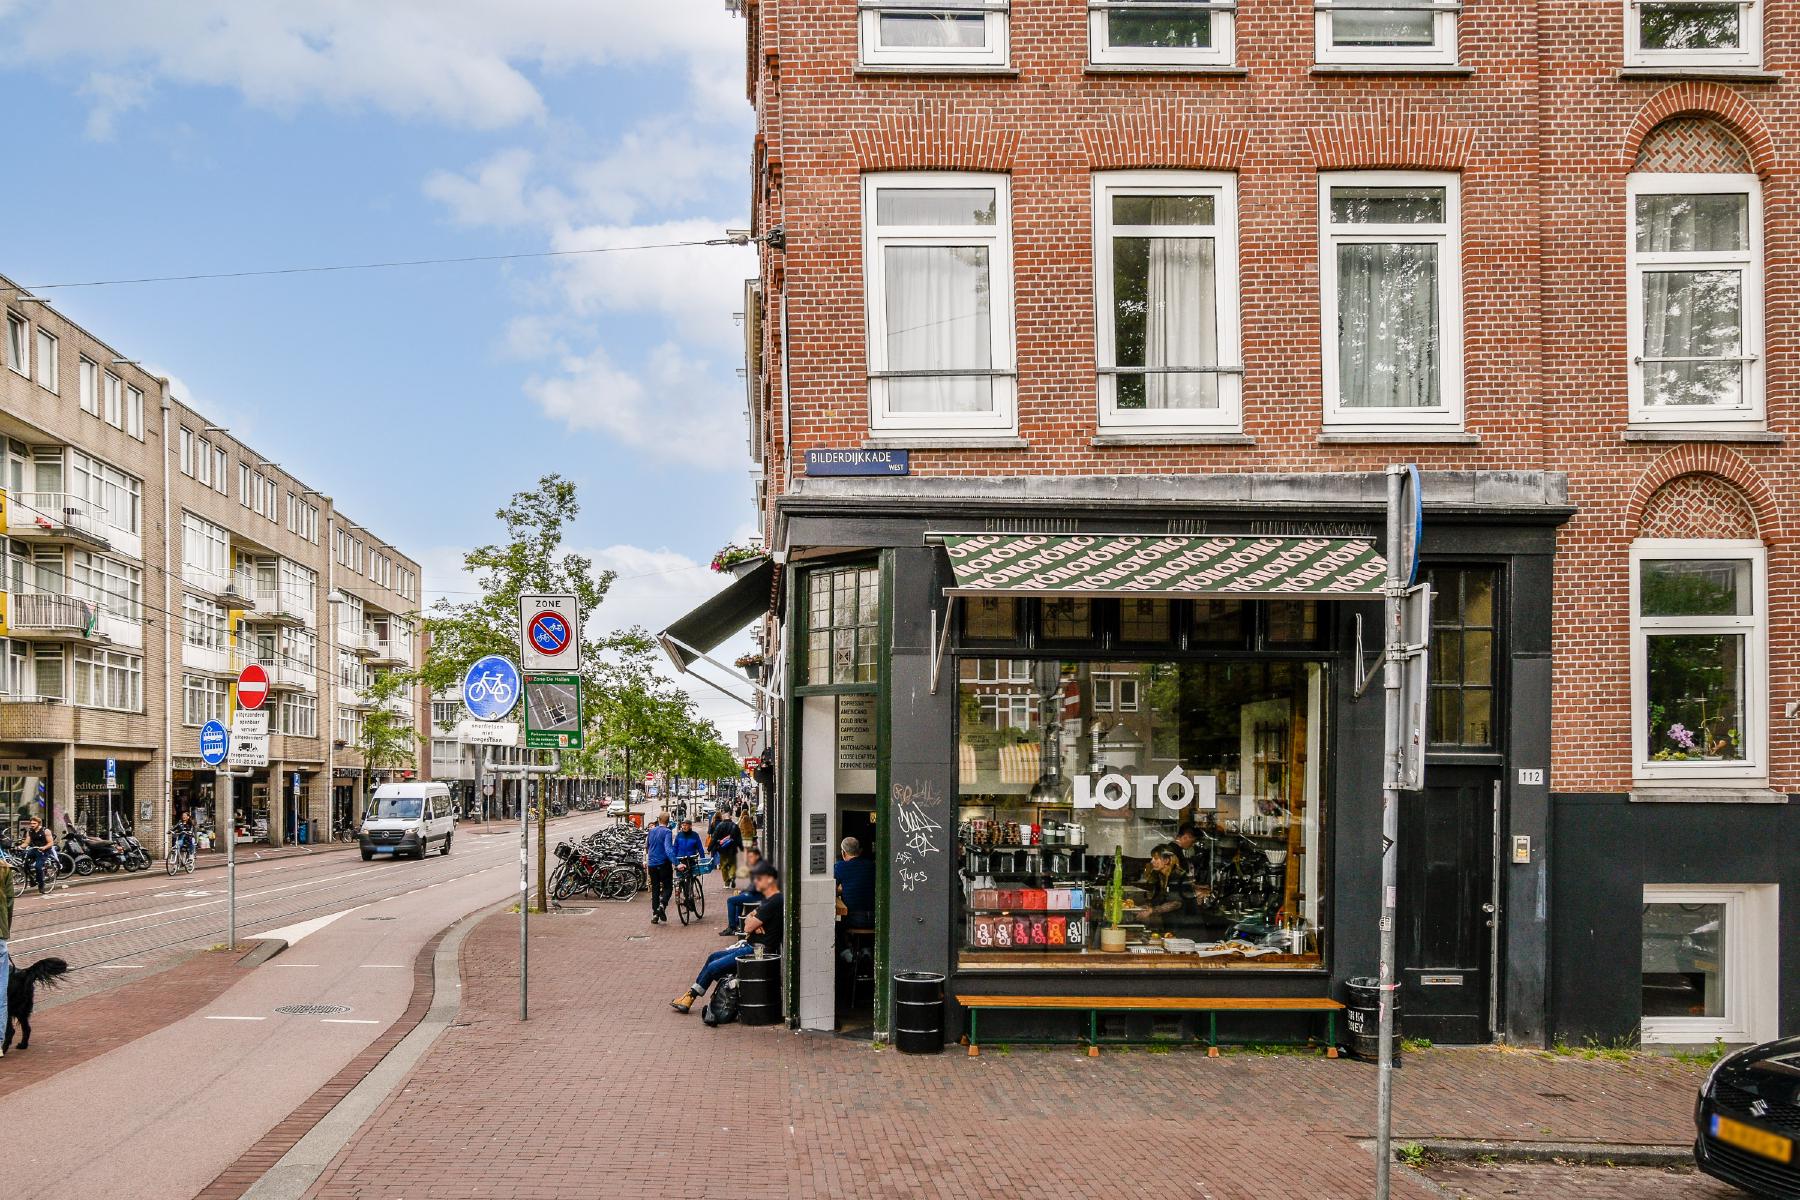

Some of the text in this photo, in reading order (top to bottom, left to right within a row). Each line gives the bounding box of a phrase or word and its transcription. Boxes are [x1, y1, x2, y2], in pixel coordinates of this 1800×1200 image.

[811, 452, 891, 465] BILDERDIJKKADE
[109, 760, 113, 770] P
[1523, 771, 1540, 782] 112
[1074, 764, 1216, 810] LOT61
